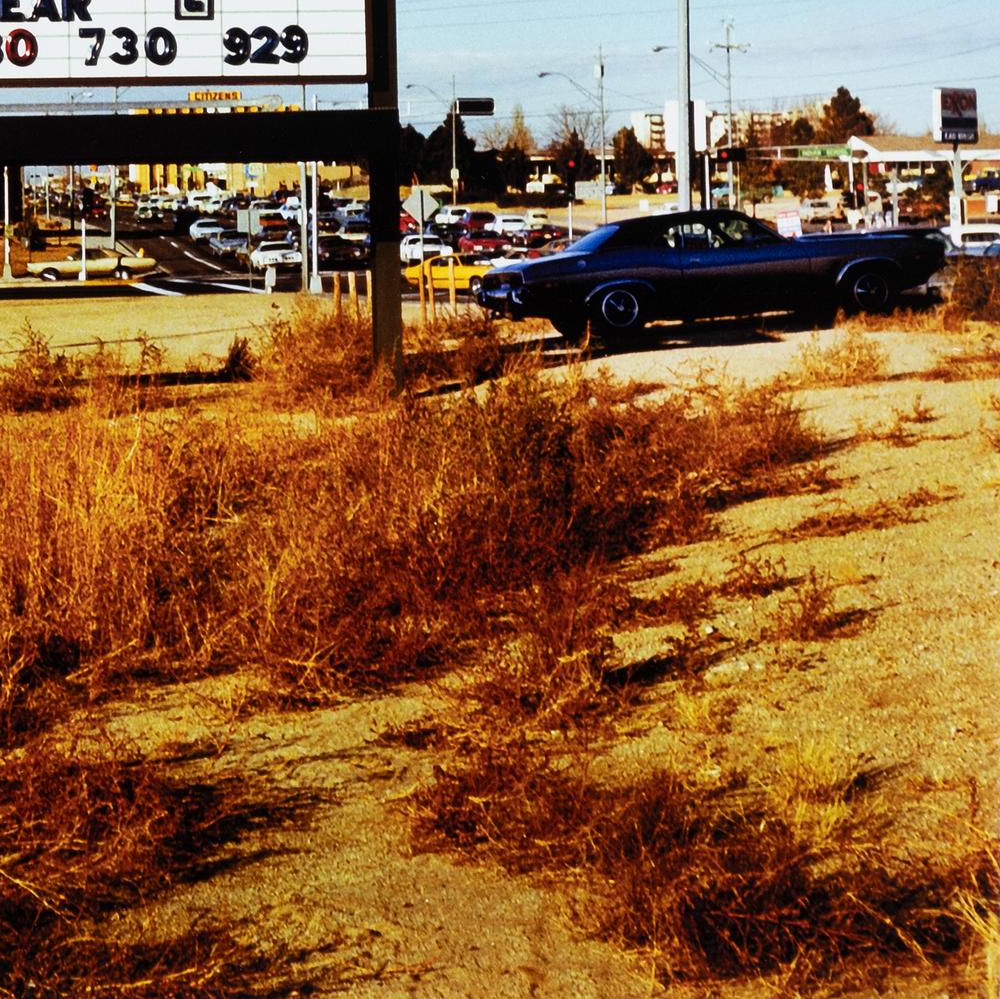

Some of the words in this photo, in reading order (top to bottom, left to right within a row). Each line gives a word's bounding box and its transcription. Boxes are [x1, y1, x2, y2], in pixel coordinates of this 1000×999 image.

[79, 27, 177, 66] 730
[223, 25, 308, 65] 929
[194, 91, 238, 101] CITIZENS
